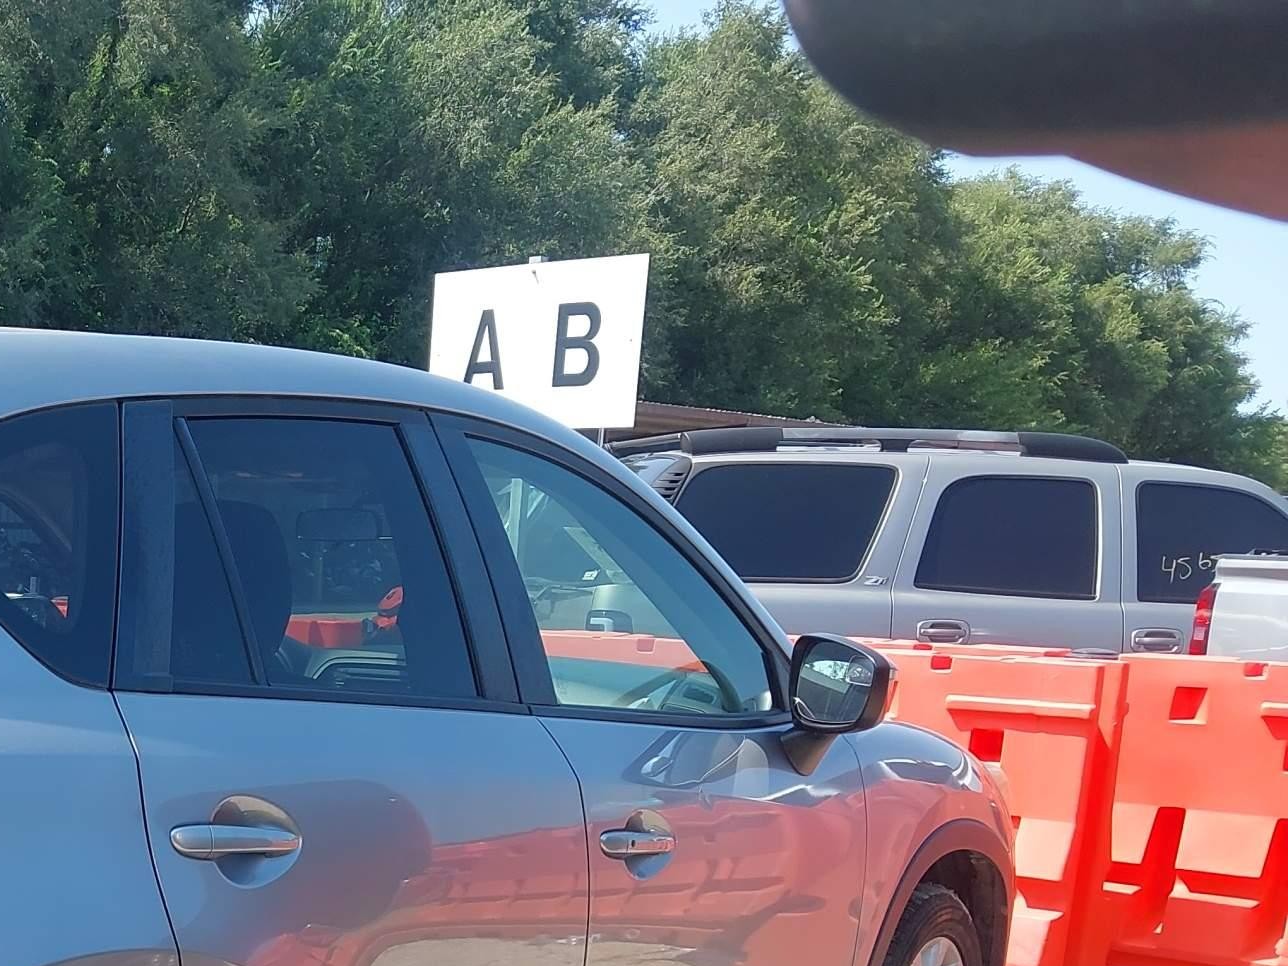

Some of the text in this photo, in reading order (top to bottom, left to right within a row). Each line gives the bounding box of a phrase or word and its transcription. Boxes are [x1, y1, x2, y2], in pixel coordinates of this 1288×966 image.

[464, 302, 602, 390] A B
[1161, 552, 1216, 584] 456
